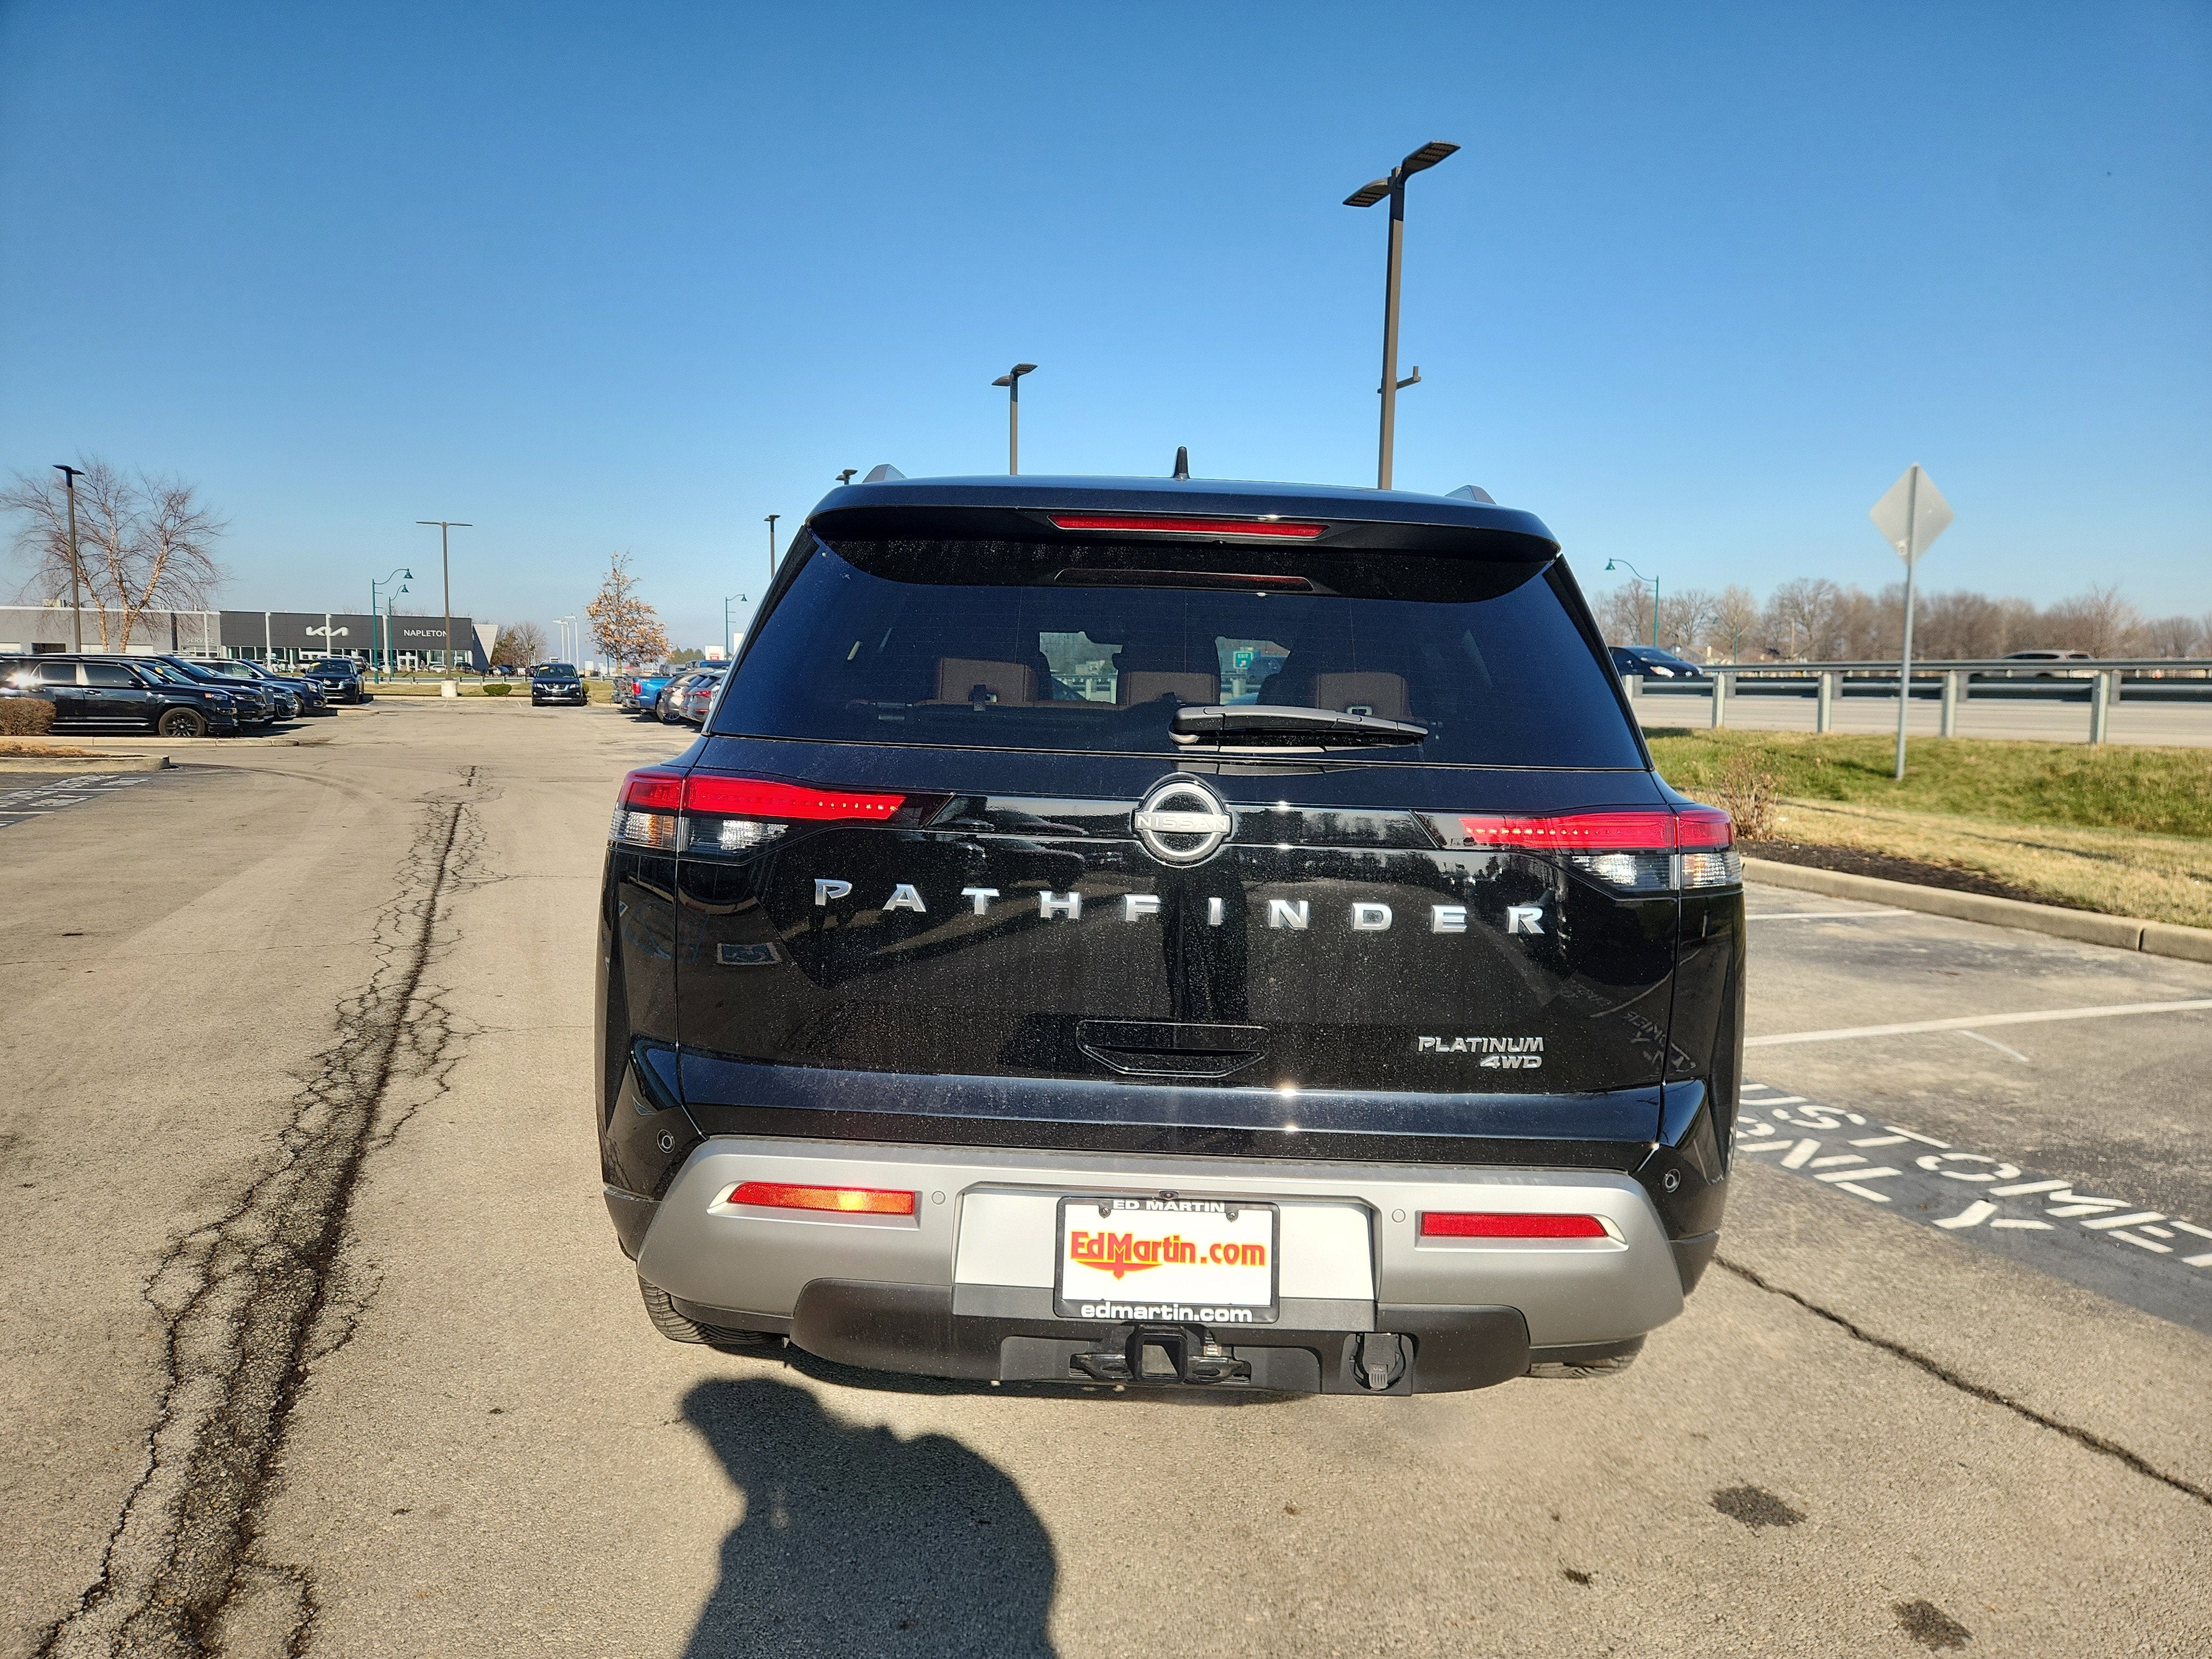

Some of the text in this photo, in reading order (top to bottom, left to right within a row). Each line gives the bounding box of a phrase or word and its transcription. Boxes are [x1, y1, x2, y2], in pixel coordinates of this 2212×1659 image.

[1137, 815, 1227, 831] NISSAN
[814, 878, 1546, 934] PATHFINDER
[1418, 1036, 1544, 1053] PLATINUM
[1480, 1054, 1542, 1069] 4WD
[1738, 1083, 2212, 1268] USTOME
[1113, 1199, 1225, 1213] ED MARTIN
[1070, 1231, 1266, 1267] EdMartin.com
[1081, 1301, 1253, 1323] edmartin.com
